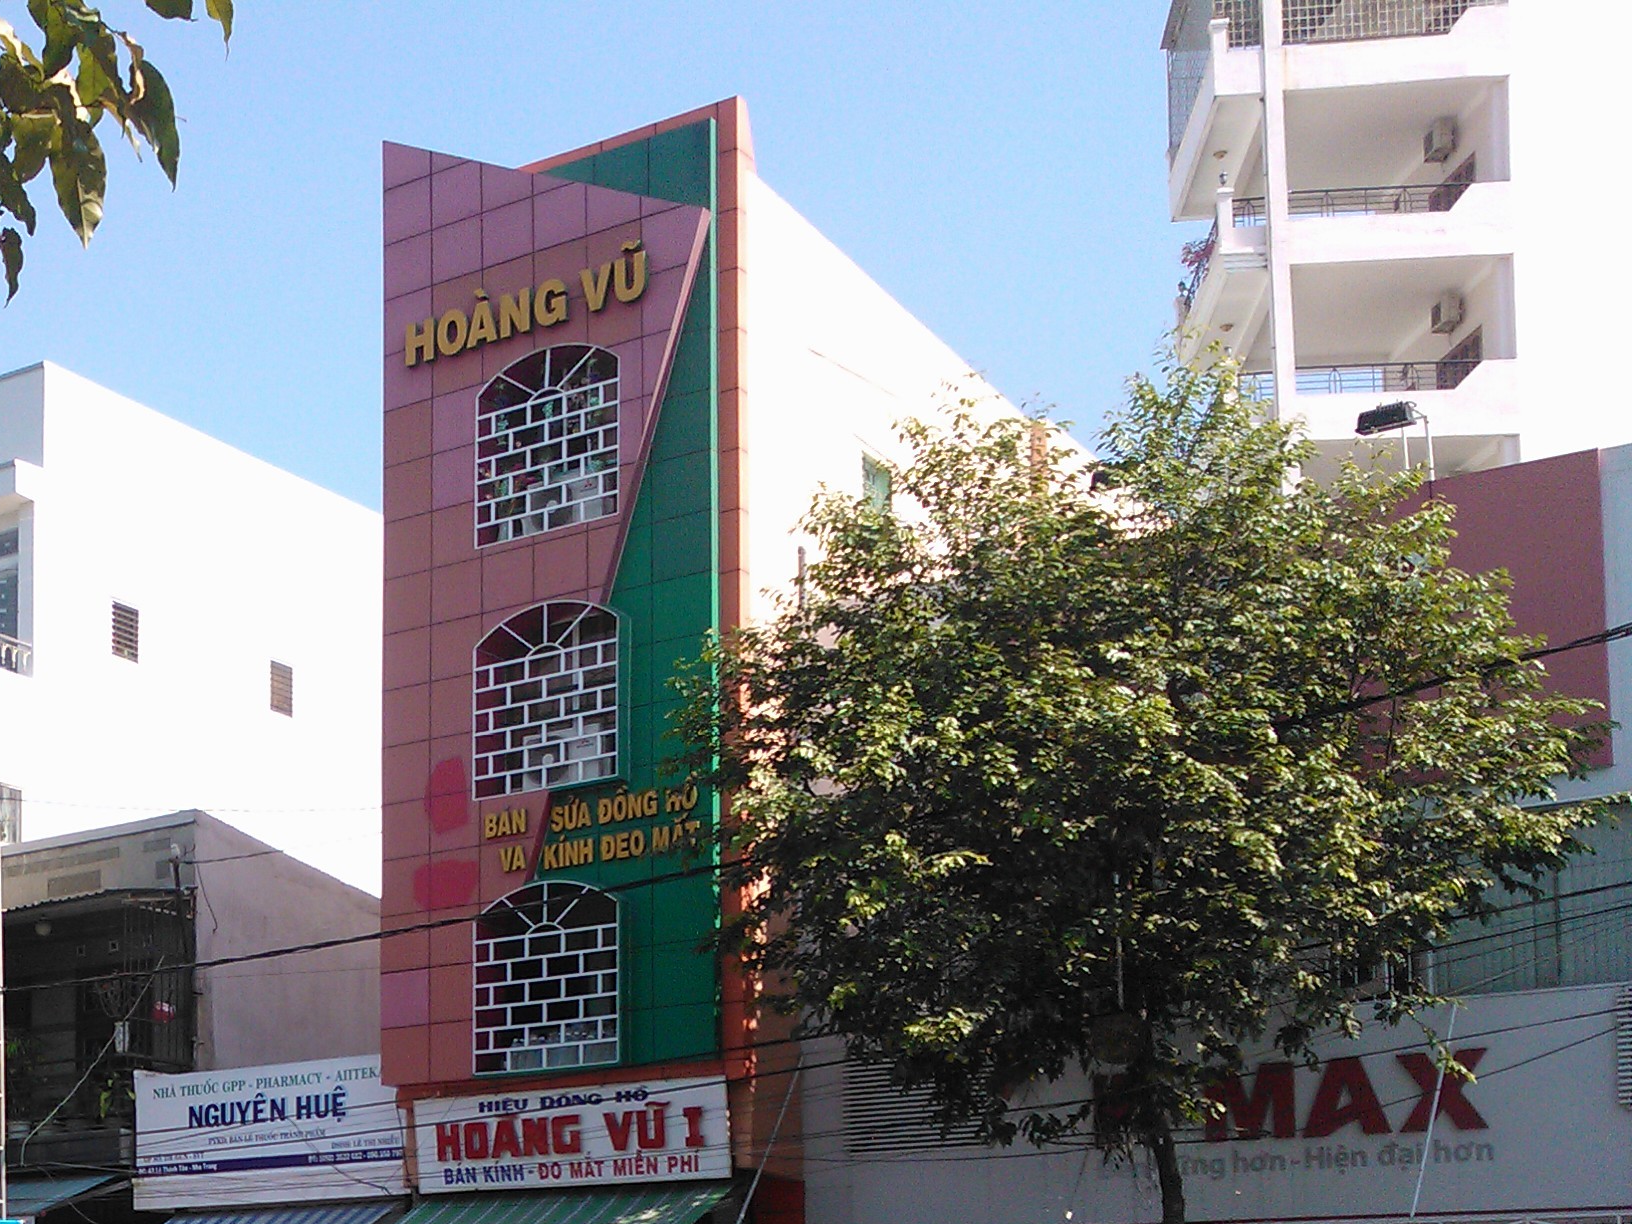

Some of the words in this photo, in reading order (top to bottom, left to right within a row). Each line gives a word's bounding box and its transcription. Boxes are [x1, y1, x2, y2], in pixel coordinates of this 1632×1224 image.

[405, 279, 569, 367] HOÀNG
[579, 239, 647, 313] VŨ
[543, 834, 594, 870] KÍNH
[600, 829, 645, 861] ĐEO
[153, 1083, 177, 1100] NHÀ
[179, 1078, 219, 1097] THUỐC
[222, 1079, 246, 1094] GPP
[256, 1071, 323, 1090] PHARMACY
[335, 1066, 381, 1082] АПТЕК
[188, 1092, 286, 1128] NGUYÊN
[296, 1085, 346, 1123] HUỆ
[435, 1113, 581, 1162] HOÀNG
[603, 1101, 670, 1151] VŨ
[1434, 1139, 1494, 1163] hơn
[443, 1162, 477, 1186] BÁN
[482, 1160, 525, 1183] KÍNH
[537, 1162, 562, 1180] ĐO
[570, 1151, 604, 1179] MẮT
[667, 1149, 700, 1174] PHÍ
